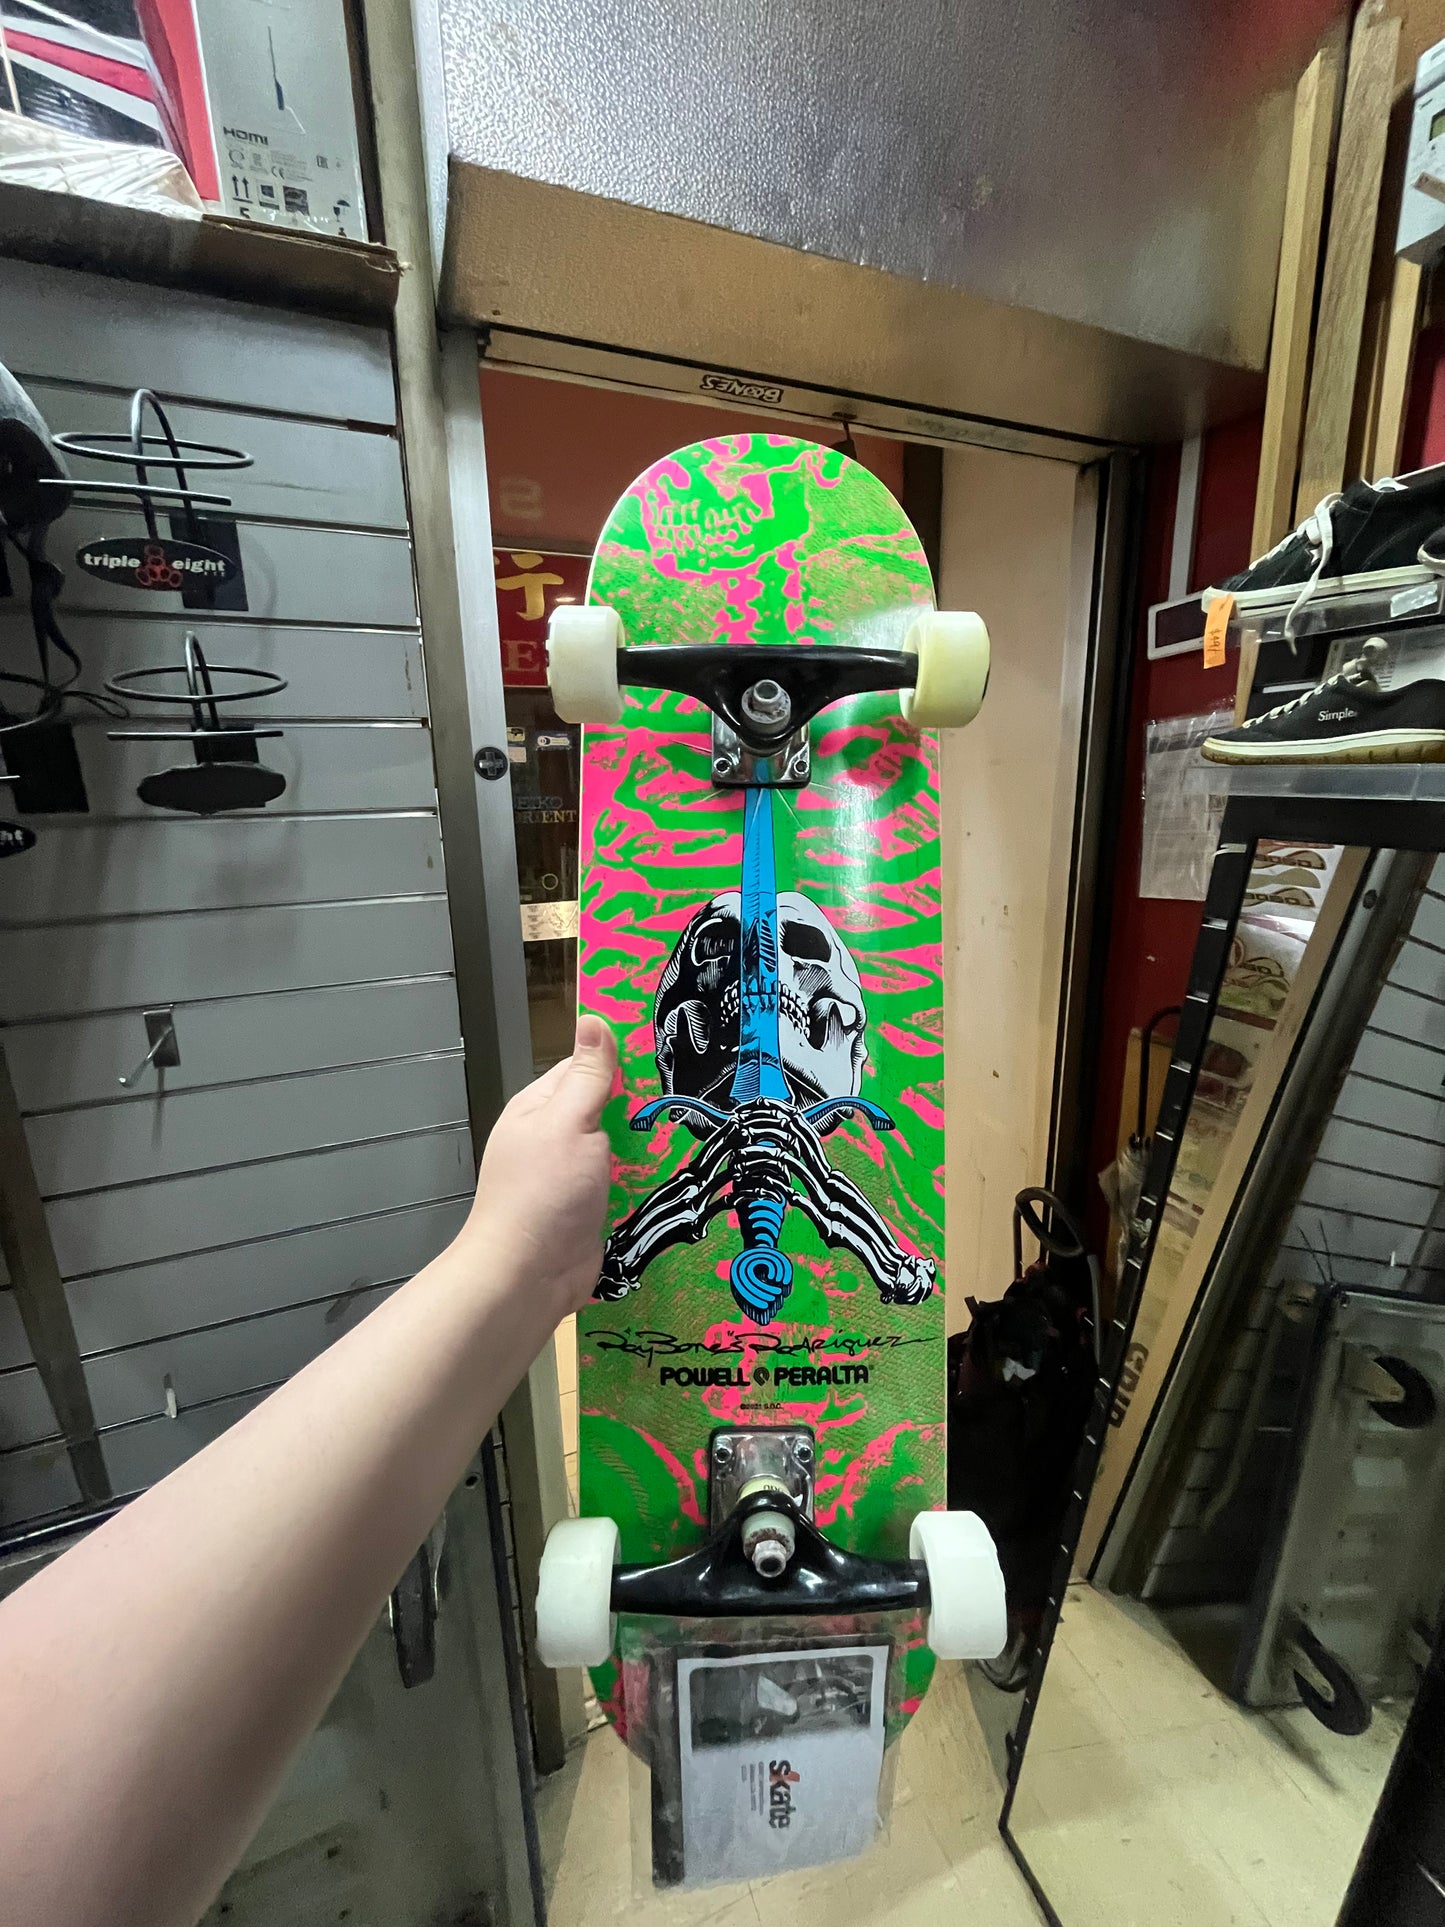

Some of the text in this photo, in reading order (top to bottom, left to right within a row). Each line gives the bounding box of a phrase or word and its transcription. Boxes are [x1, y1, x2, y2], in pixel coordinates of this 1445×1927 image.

[701, 375, 783, 402] BONES
[84, 553, 225, 573] triple eight
[1318, 708, 1355, 721] Simple
[659, 1364, 869, 1386] POWELL PERALTA
